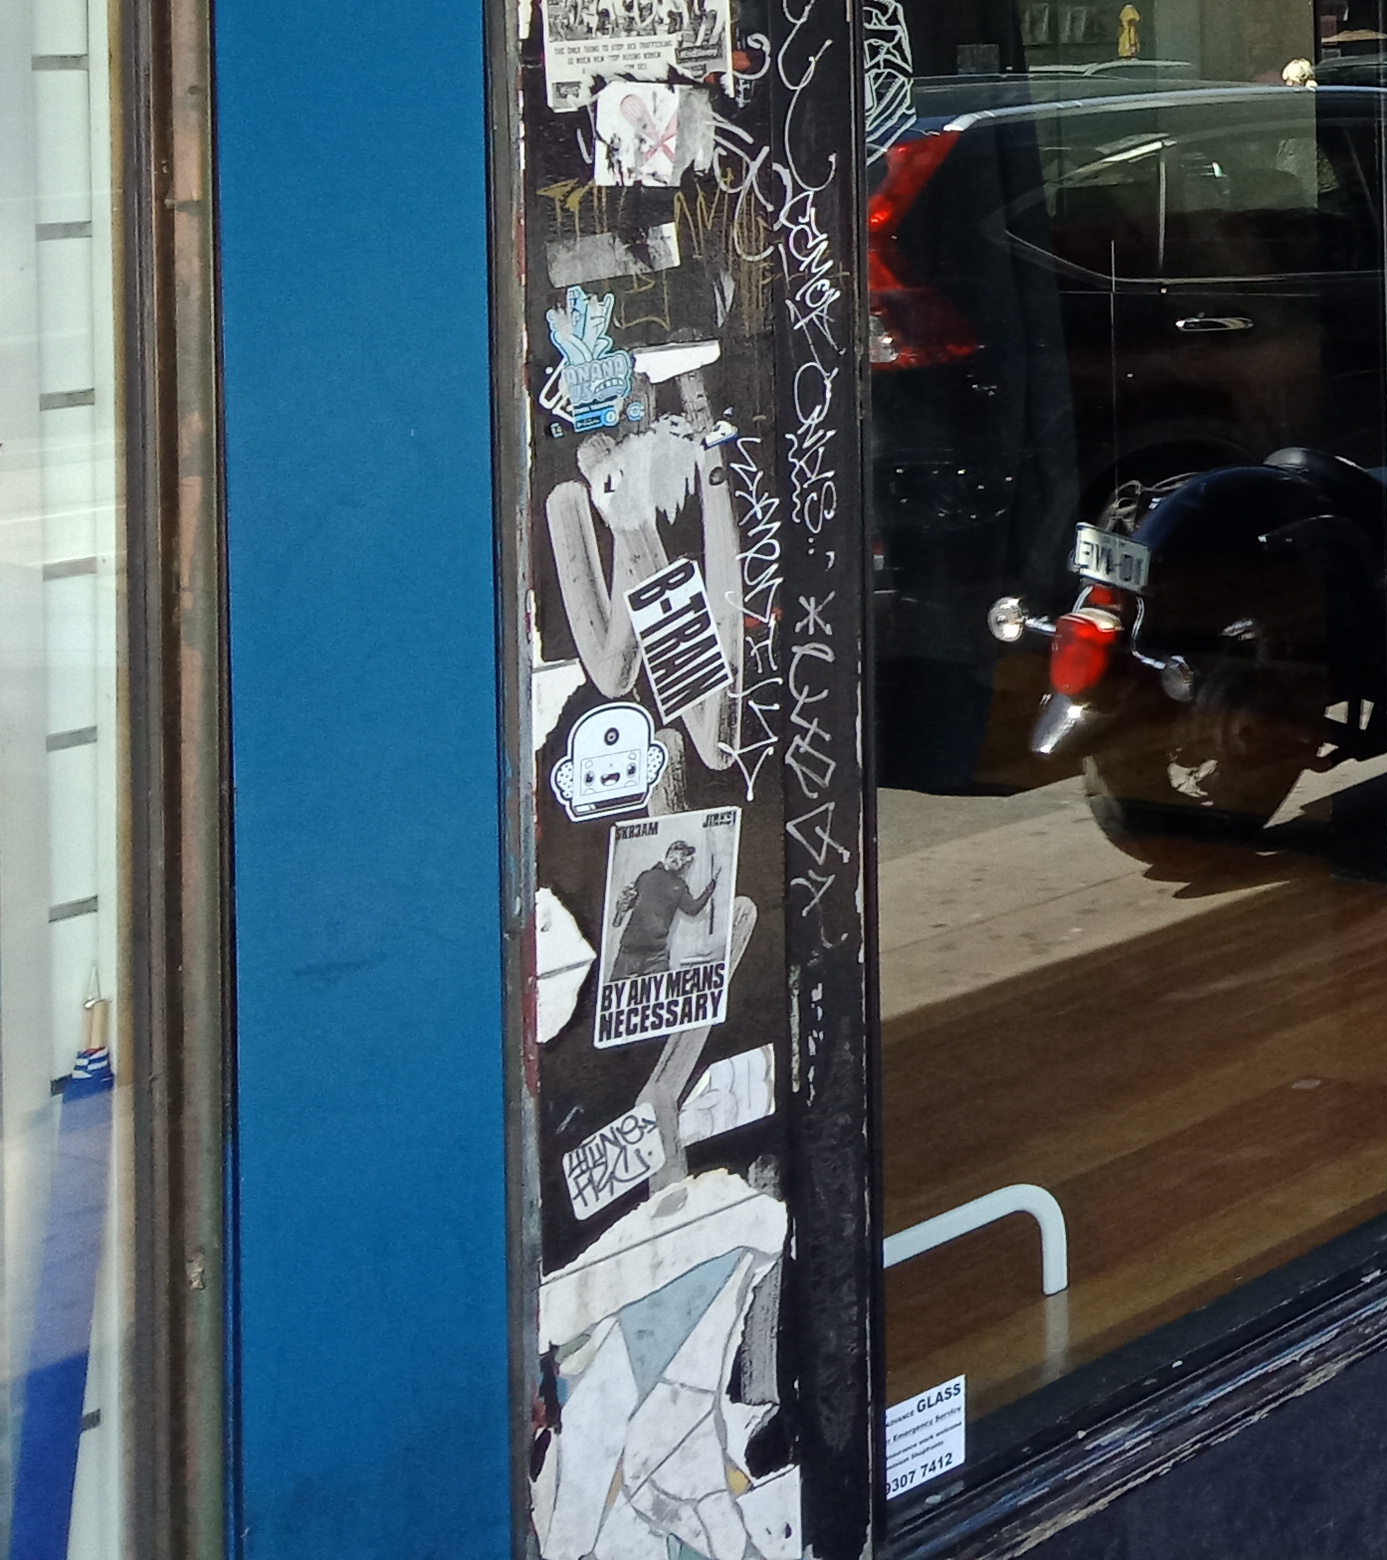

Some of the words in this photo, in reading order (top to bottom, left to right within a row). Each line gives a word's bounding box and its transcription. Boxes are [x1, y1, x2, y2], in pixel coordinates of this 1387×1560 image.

[627, 559, 729, 715] B-TRAIN
[601, 980, 626, 1013] BY
[627, 973, 665, 1008] ANY
[666, 962, 726, 1000] MEANS
[599, 989, 724, 1042] NECESSARY
[916, 1382, 962, 1413] GLASS
[886, 1470, 917, 1496] 9307
[920, 1452, 954, 1479] 7412
